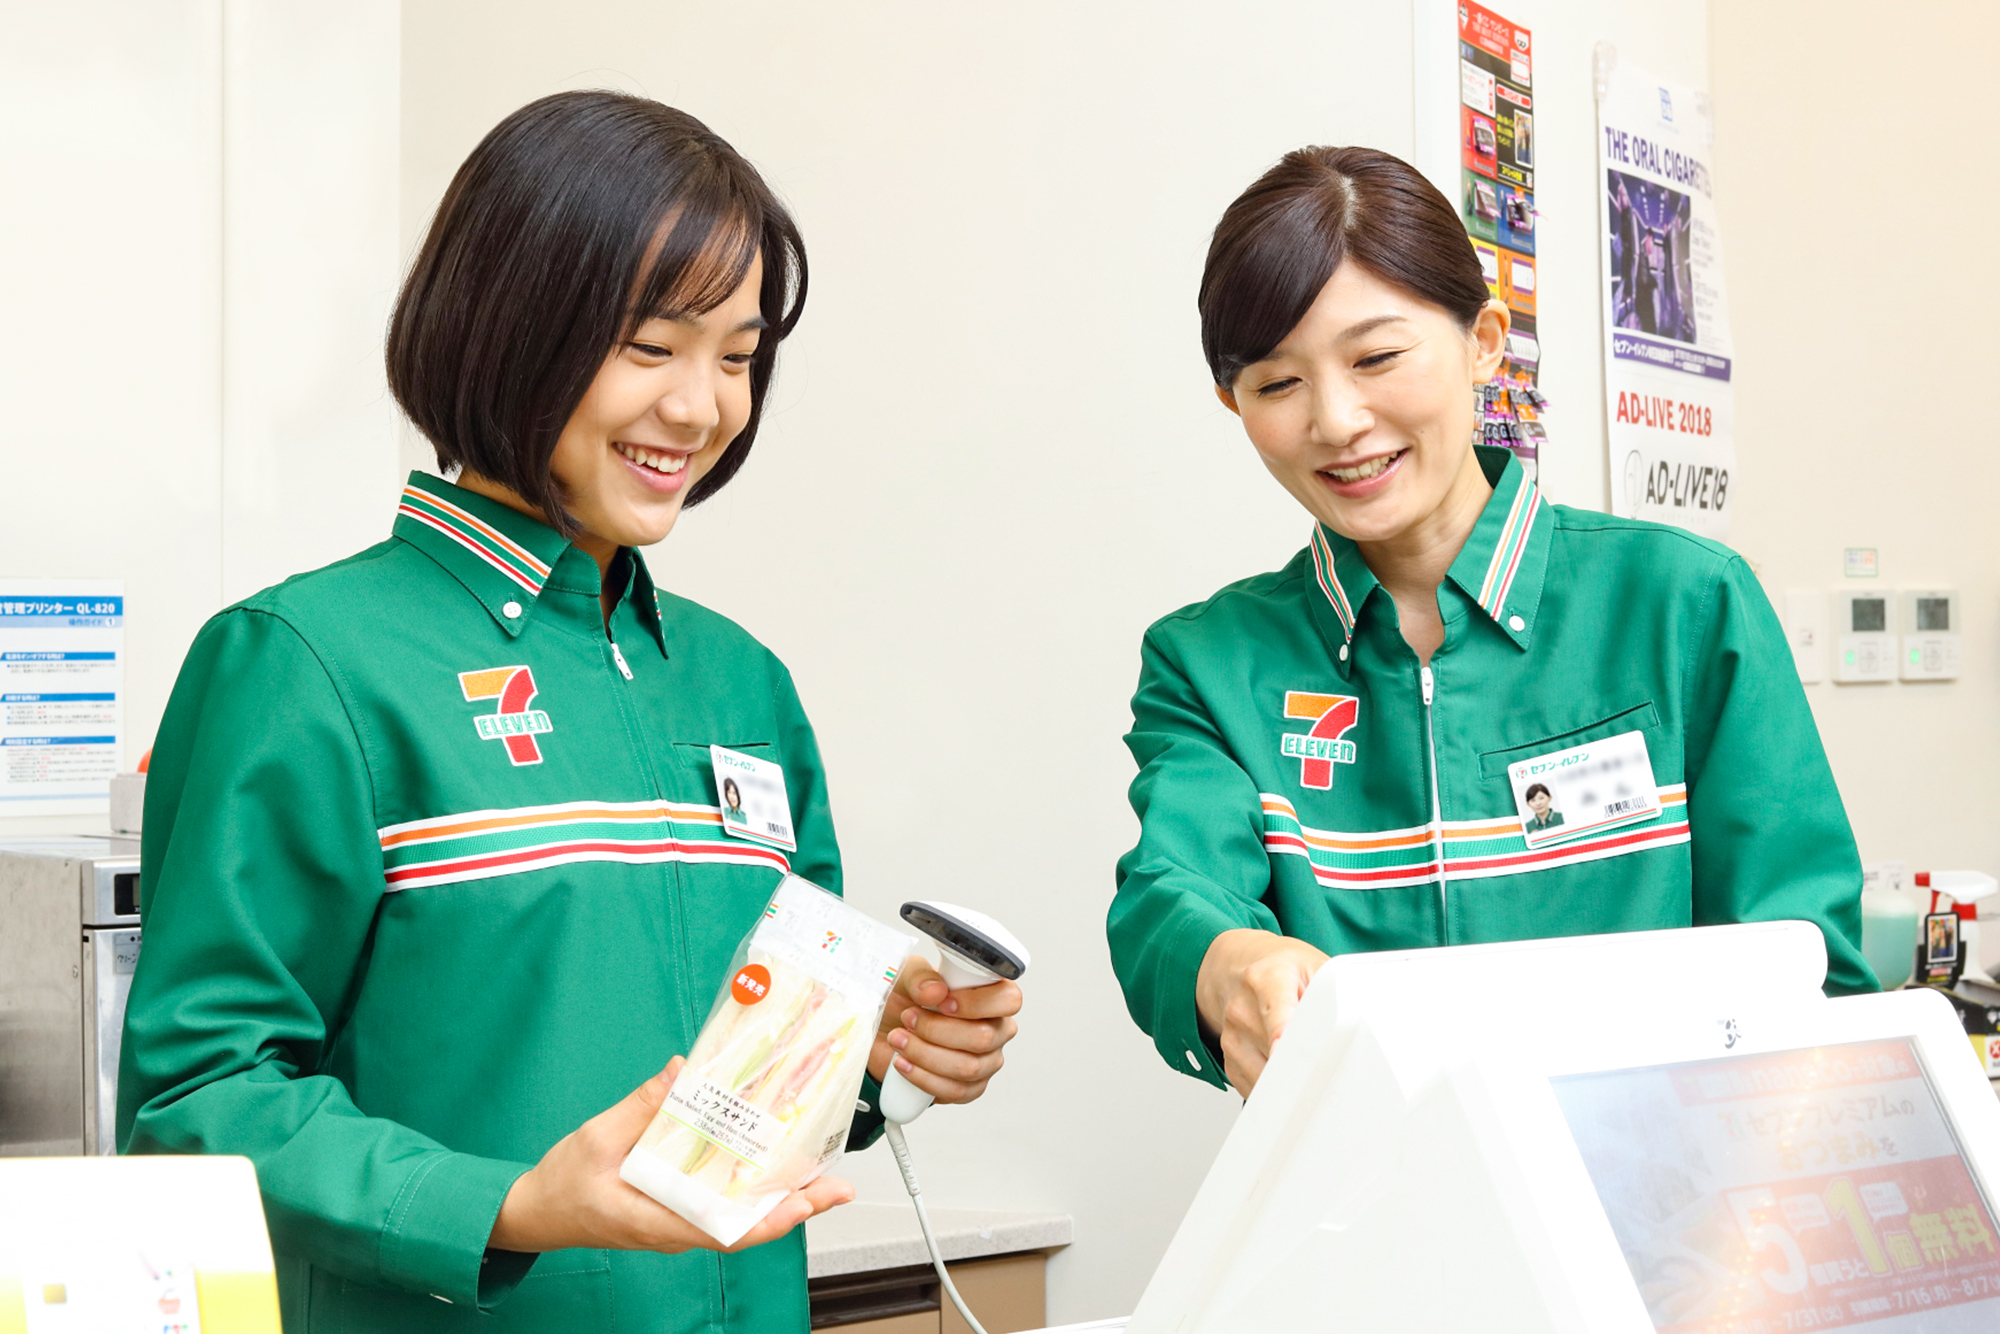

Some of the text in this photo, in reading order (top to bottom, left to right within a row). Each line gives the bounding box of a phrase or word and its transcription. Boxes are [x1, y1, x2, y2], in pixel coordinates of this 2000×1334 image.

[1605, 126, 1630, 164] THE
[1632, 135, 1662, 175] ORAL
[1617, 391, 1712, 437] AD-LIVE 2018
[0, 602, 115, 615] 管理プリンター QL-820
[736, 973, 766, 997] 新発売
[669, 1091, 684, 1104] Tuna
[703, 1111, 715, 1123] Egg
[715, 1118, 726, 1128] and
[726, 1123, 739, 1136] Ham
[693, 1089, 758, 1132] ミックスサンド
